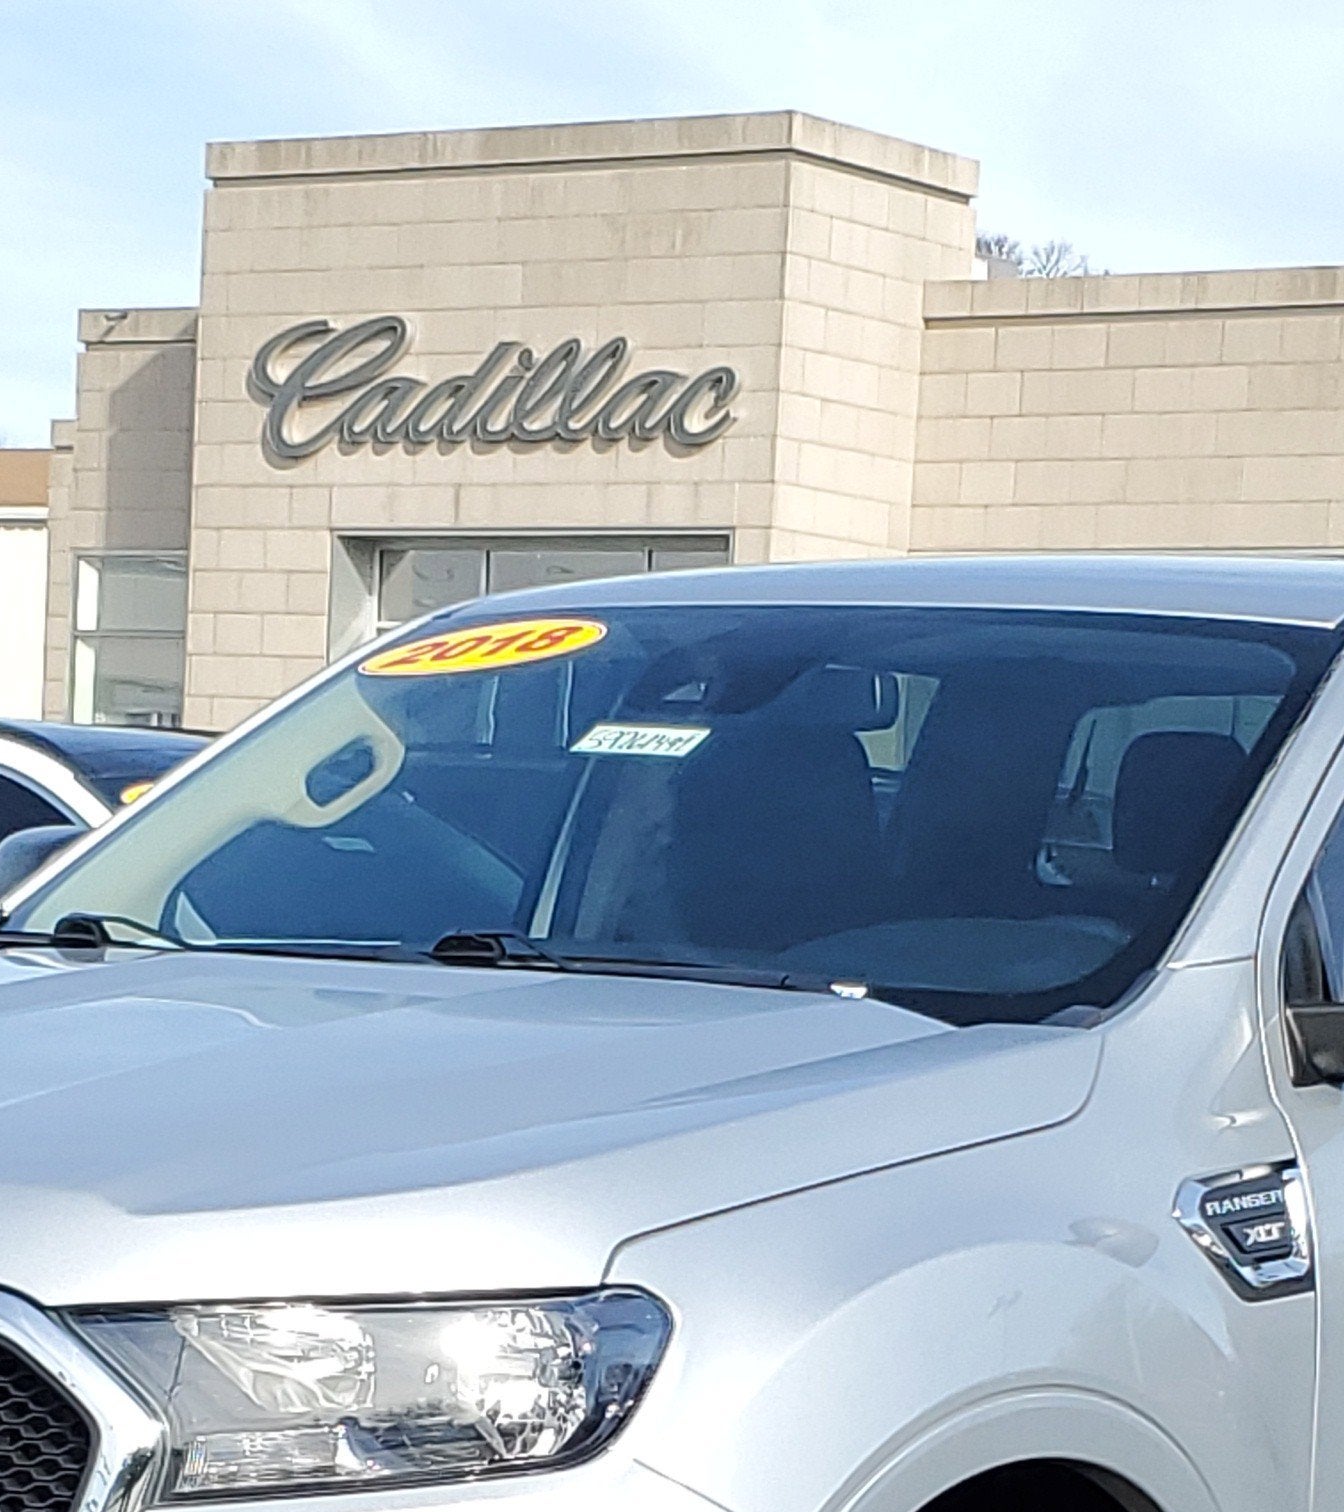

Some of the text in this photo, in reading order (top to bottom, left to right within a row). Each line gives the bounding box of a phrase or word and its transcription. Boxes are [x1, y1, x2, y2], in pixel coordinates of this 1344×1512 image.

[248, 315, 738, 458] Cadillac
[1205, 1188, 1285, 1217] RANGER
[1243, 1221, 1285, 1247] XLT
